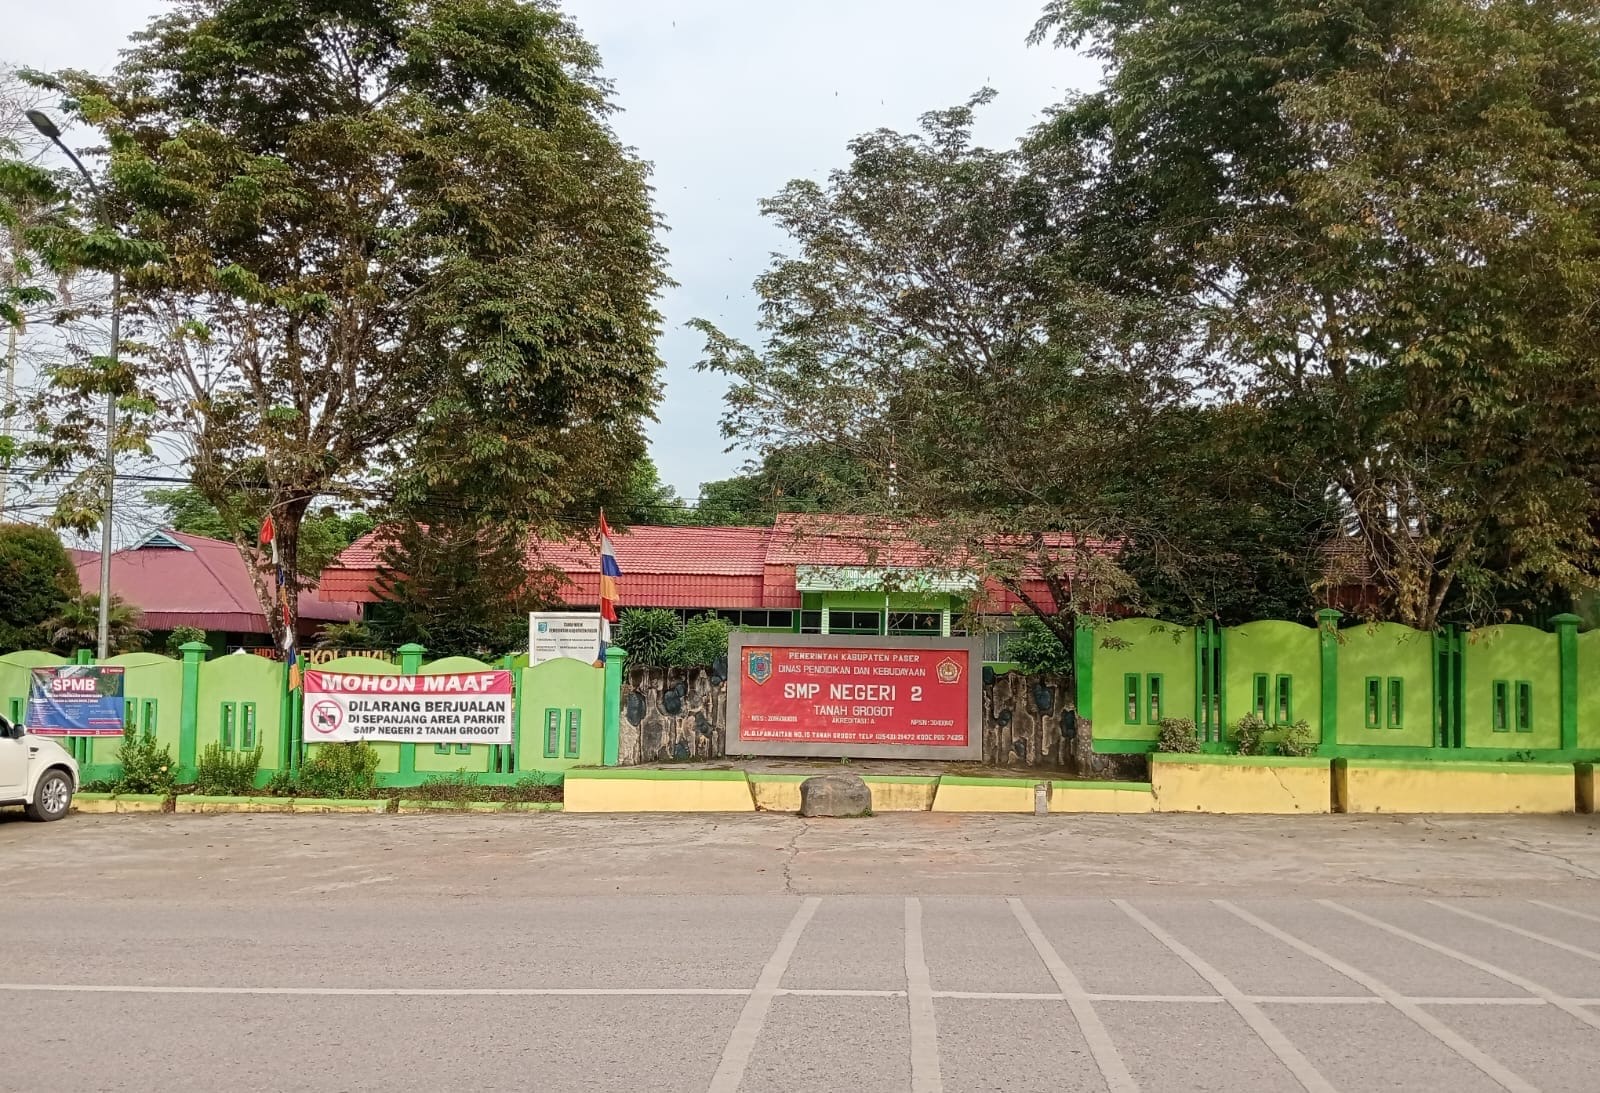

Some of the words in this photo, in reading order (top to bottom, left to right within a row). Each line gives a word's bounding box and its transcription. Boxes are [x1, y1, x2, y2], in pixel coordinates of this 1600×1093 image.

[841, 653, 889, 662] KABUPATEN
[892, 654, 920, 662] PASER
[778, 664, 801, 673] DINAS
[804, 666, 850, 675] PENDIDIKAN
[854, 666, 870, 675] DAN
[873, 668, 926, 676] KEBUDAYAAN
[53, 679, 95, 691] SPMB
[322, 674, 415, 692] MOHON
[424, 674, 495, 692] MAAF
[784, 683, 820, 699] SMP
[830, 684, 896, 701] NEGERI
[911, 686, 922, 702] 2
[350, 701, 420, 712] DILARANG
[425, 701, 505, 713] BERJUALAN
[814, 705, 848, 716] TANAH
[852, 706, 894, 716] GROGOT
[348, 714, 360, 724] DI
[362, 714, 428, 724] SEPANJANG
[430, 715, 460, 724] AREA
[464, 715, 505, 724] PARKIR
[354, 726, 376, 734] SMP
[378, 726, 414, 734] NEGERI
[416, 726, 422, 734] 2
[425, 726, 456, 734] TANAH
[459, 726, 500, 734] GROGOT
